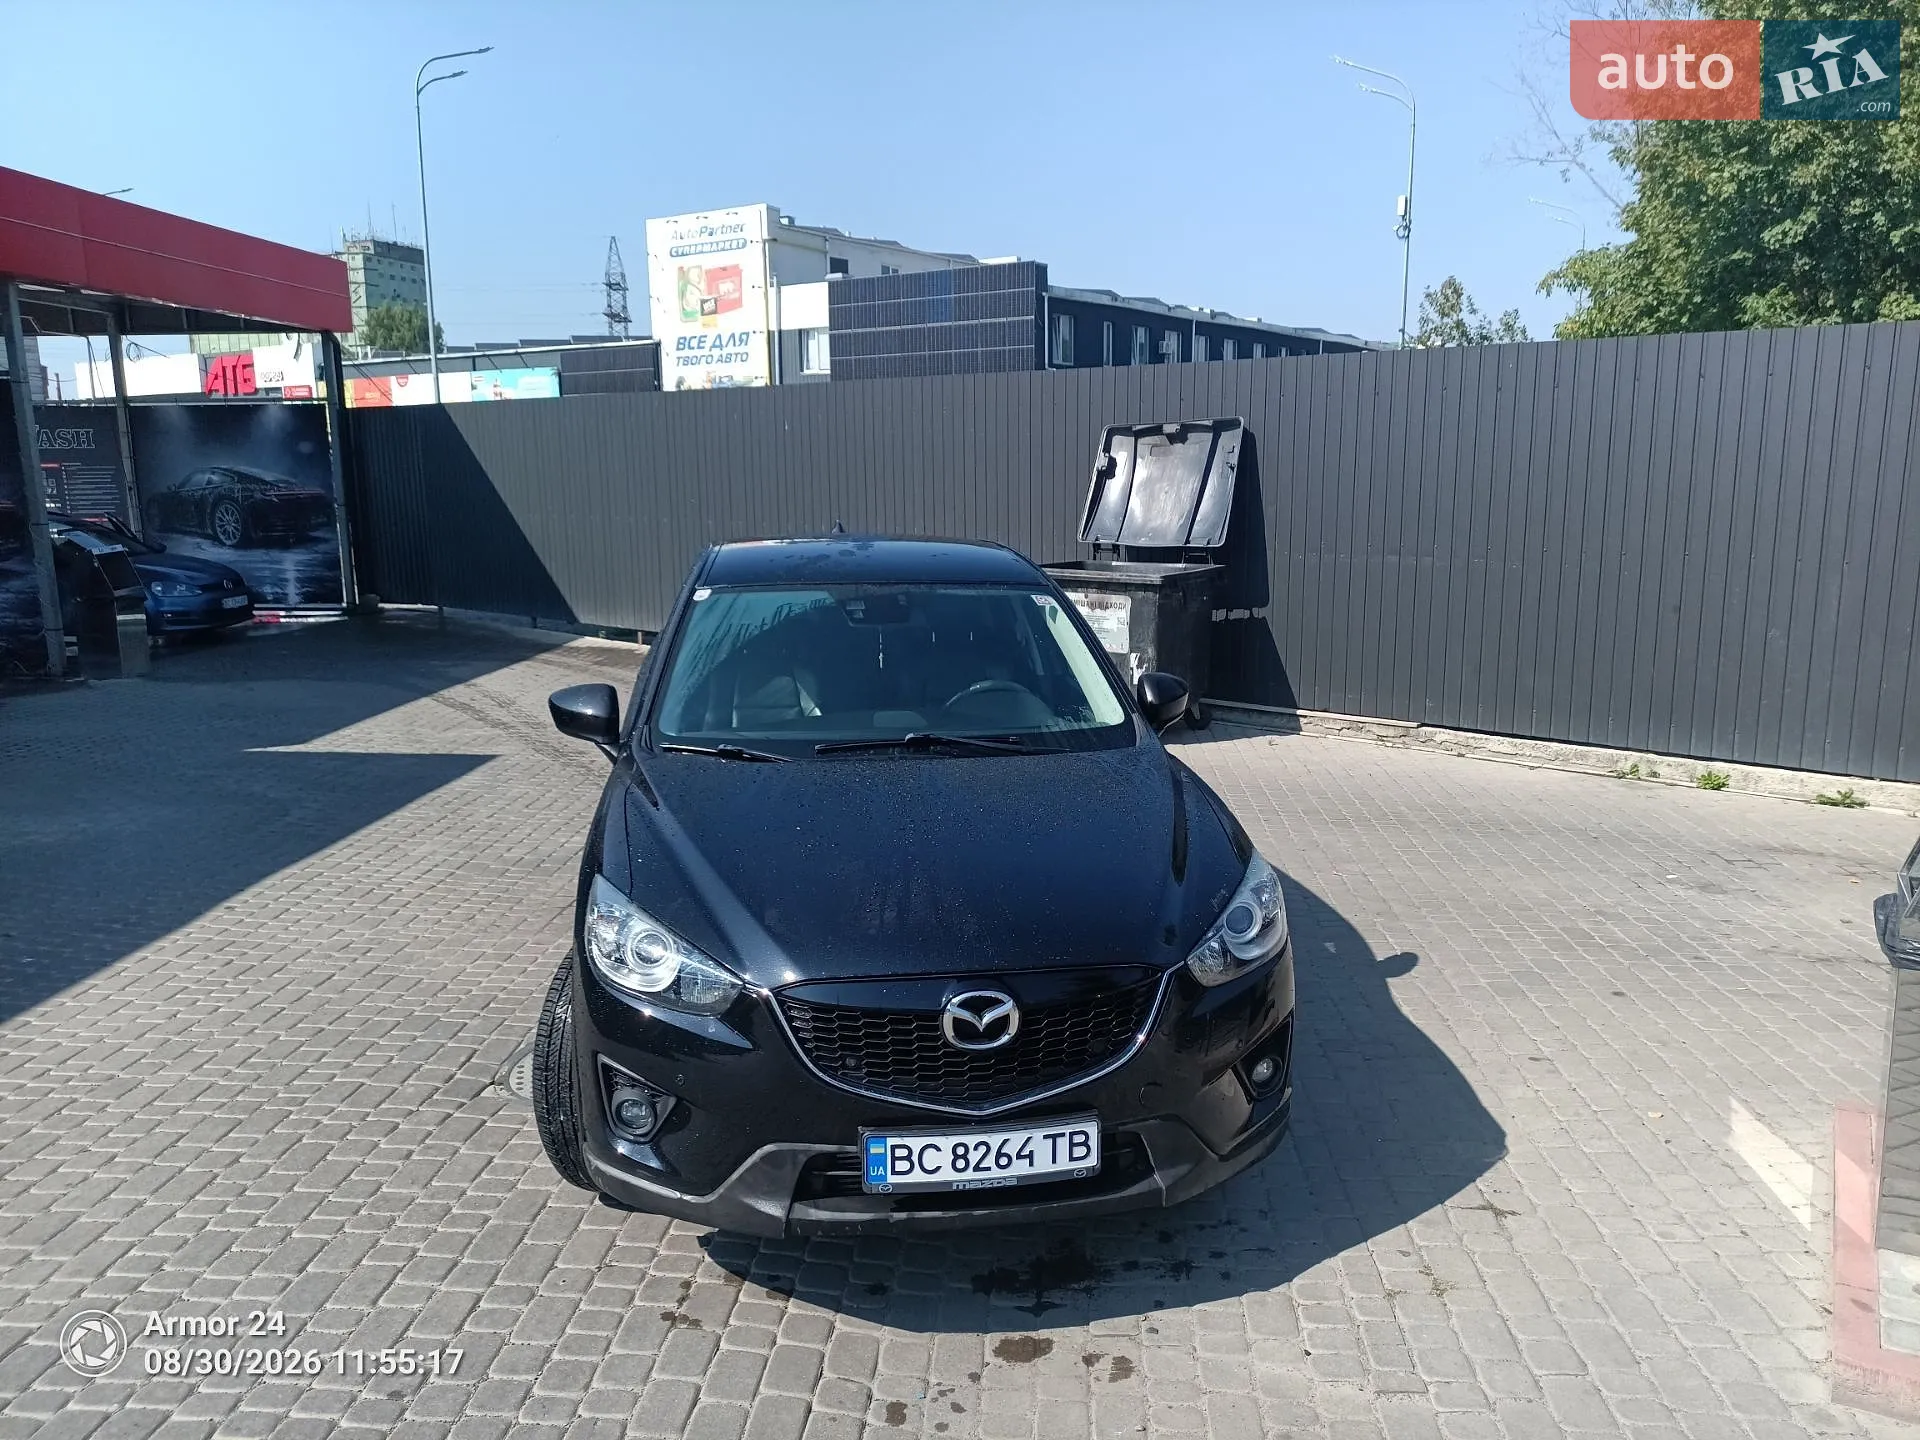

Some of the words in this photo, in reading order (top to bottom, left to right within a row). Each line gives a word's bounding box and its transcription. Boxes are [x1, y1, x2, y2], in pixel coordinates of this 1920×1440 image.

[671, 223, 747, 240] AutoPartner
[671, 239, 745, 256] СУПЕРМАРКЕТ
[675, 335, 708, 351] ВСЕ
[709, 331, 750, 352] ДЛЯ
[675, 354, 714, 367] ТВОГО
[715, 352, 749, 364] АВТО
[34, 424, 95, 449] ASH
[870, 1167, 886, 1176] UA
[890, 1143, 943, 1176] BC
[951, 1136, 1035, 1173] 8264
[1042, 1130, 1092, 1165] TB
